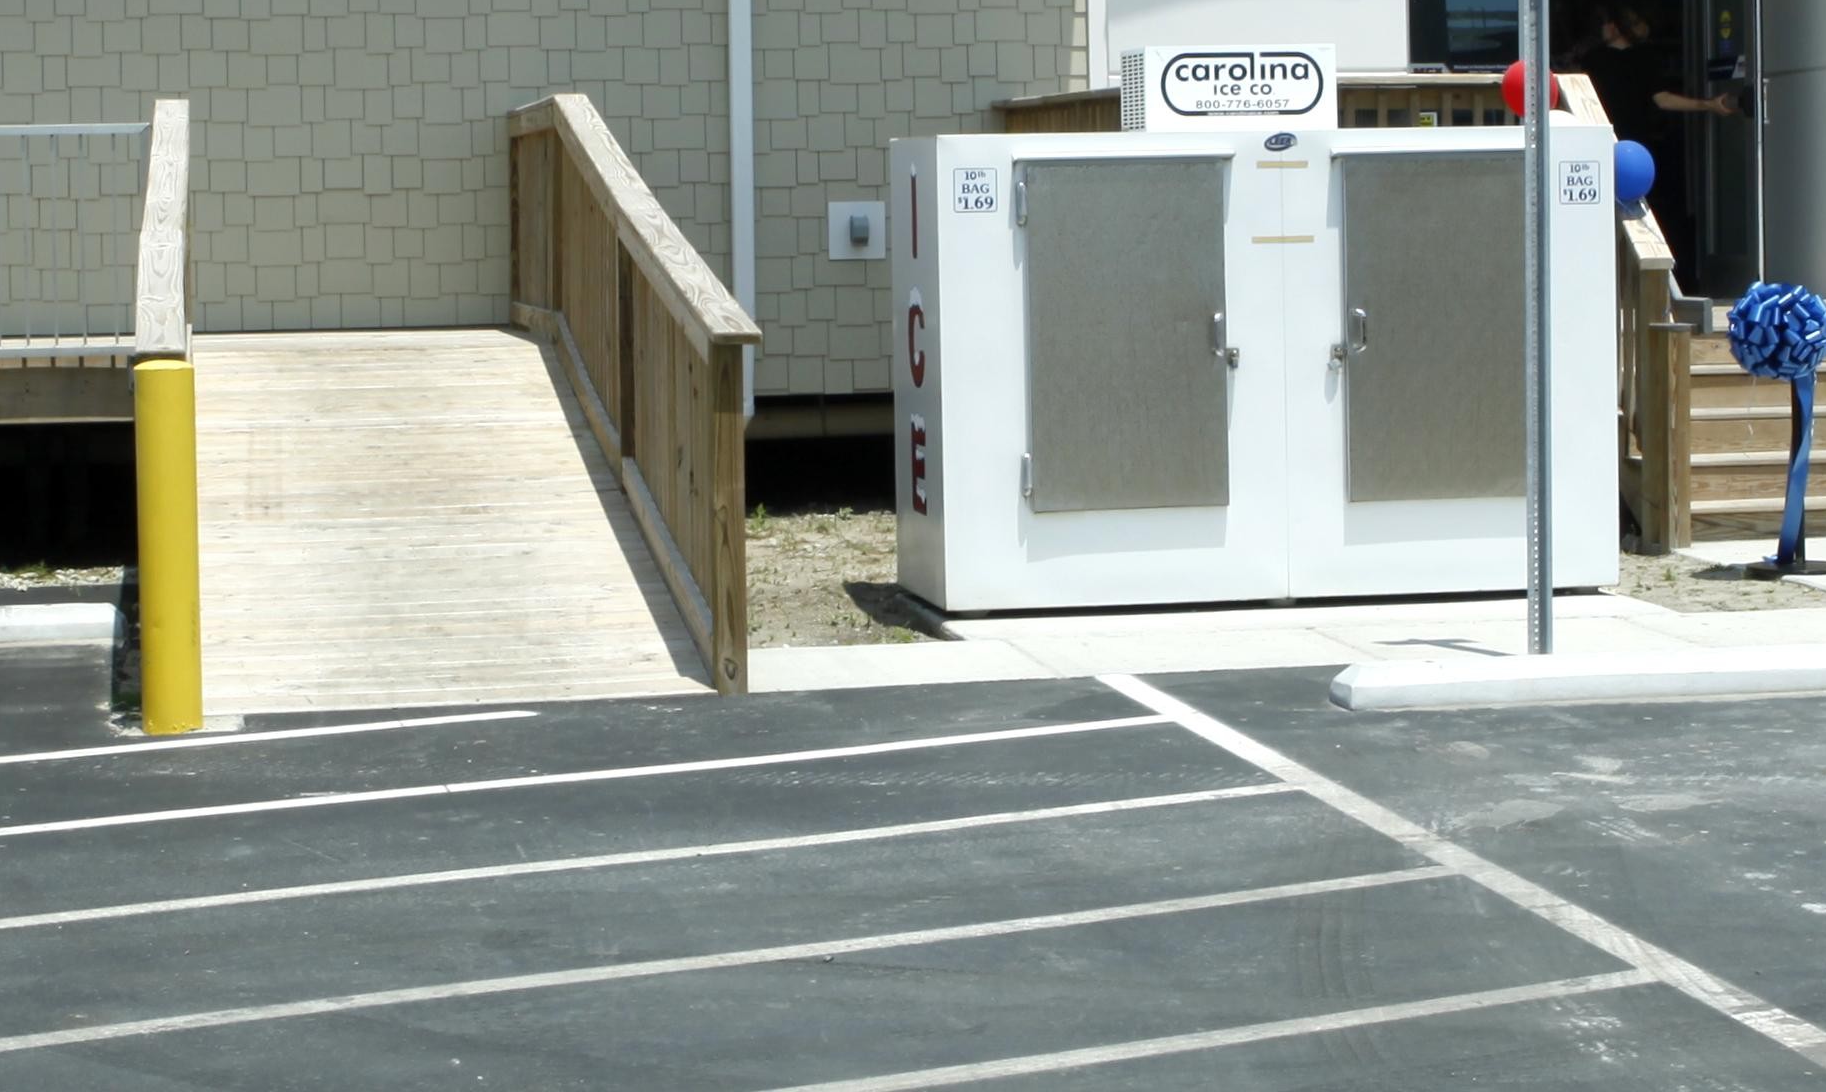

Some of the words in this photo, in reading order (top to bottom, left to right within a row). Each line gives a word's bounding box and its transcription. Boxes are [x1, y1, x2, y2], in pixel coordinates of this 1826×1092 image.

[1175, 58, 1309, 81] carolina
[1196, 99, 1290, 110] 800-776-6057
[1567, 176, 1593, 186] BAG
[962, 183, 990, 194] BAG
[1563, 188, 1597, 201] $1.69
[958, 196, 994, 209] $1.69
[908, 162, 928, 516] ICE
